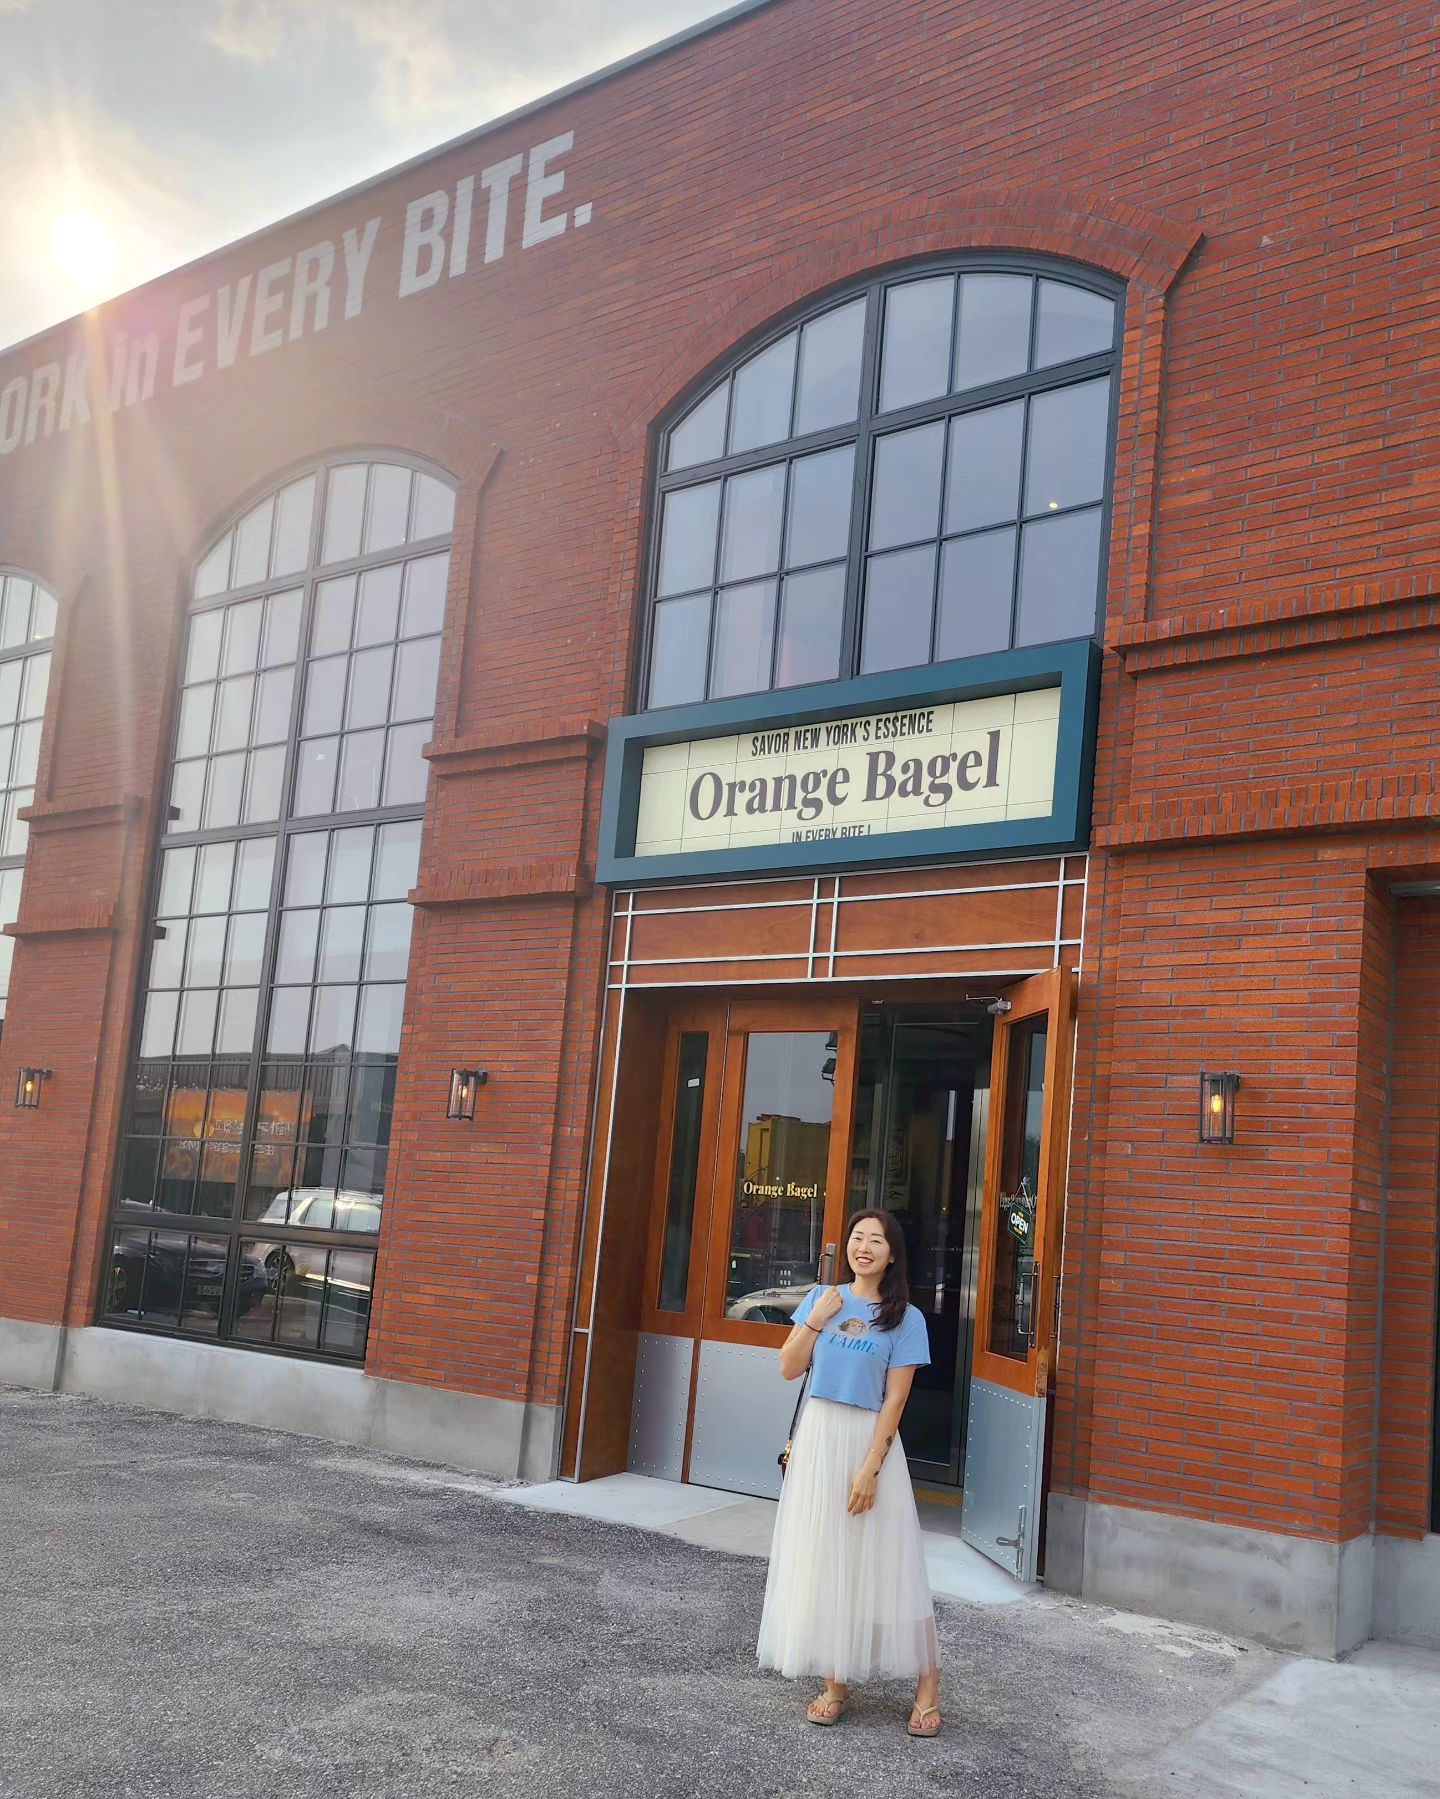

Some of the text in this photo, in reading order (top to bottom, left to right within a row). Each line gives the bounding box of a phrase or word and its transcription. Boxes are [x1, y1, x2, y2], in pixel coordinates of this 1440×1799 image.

[172, 216, 382, 388] EVERY
[399, 130, 593, 299] BITE.
[751, 710, 935, 757] SAVOR NEW YORK'S ESSENCE
[689, 729, 1002, 821] Orange Bagel
[792, 830, 803, 843] IN
[805, 826, 838, 842] EVERY
[743, 1181, 818, 1200] Orange Bagel
[1010, 1212, 1029, 1234] OPEN
